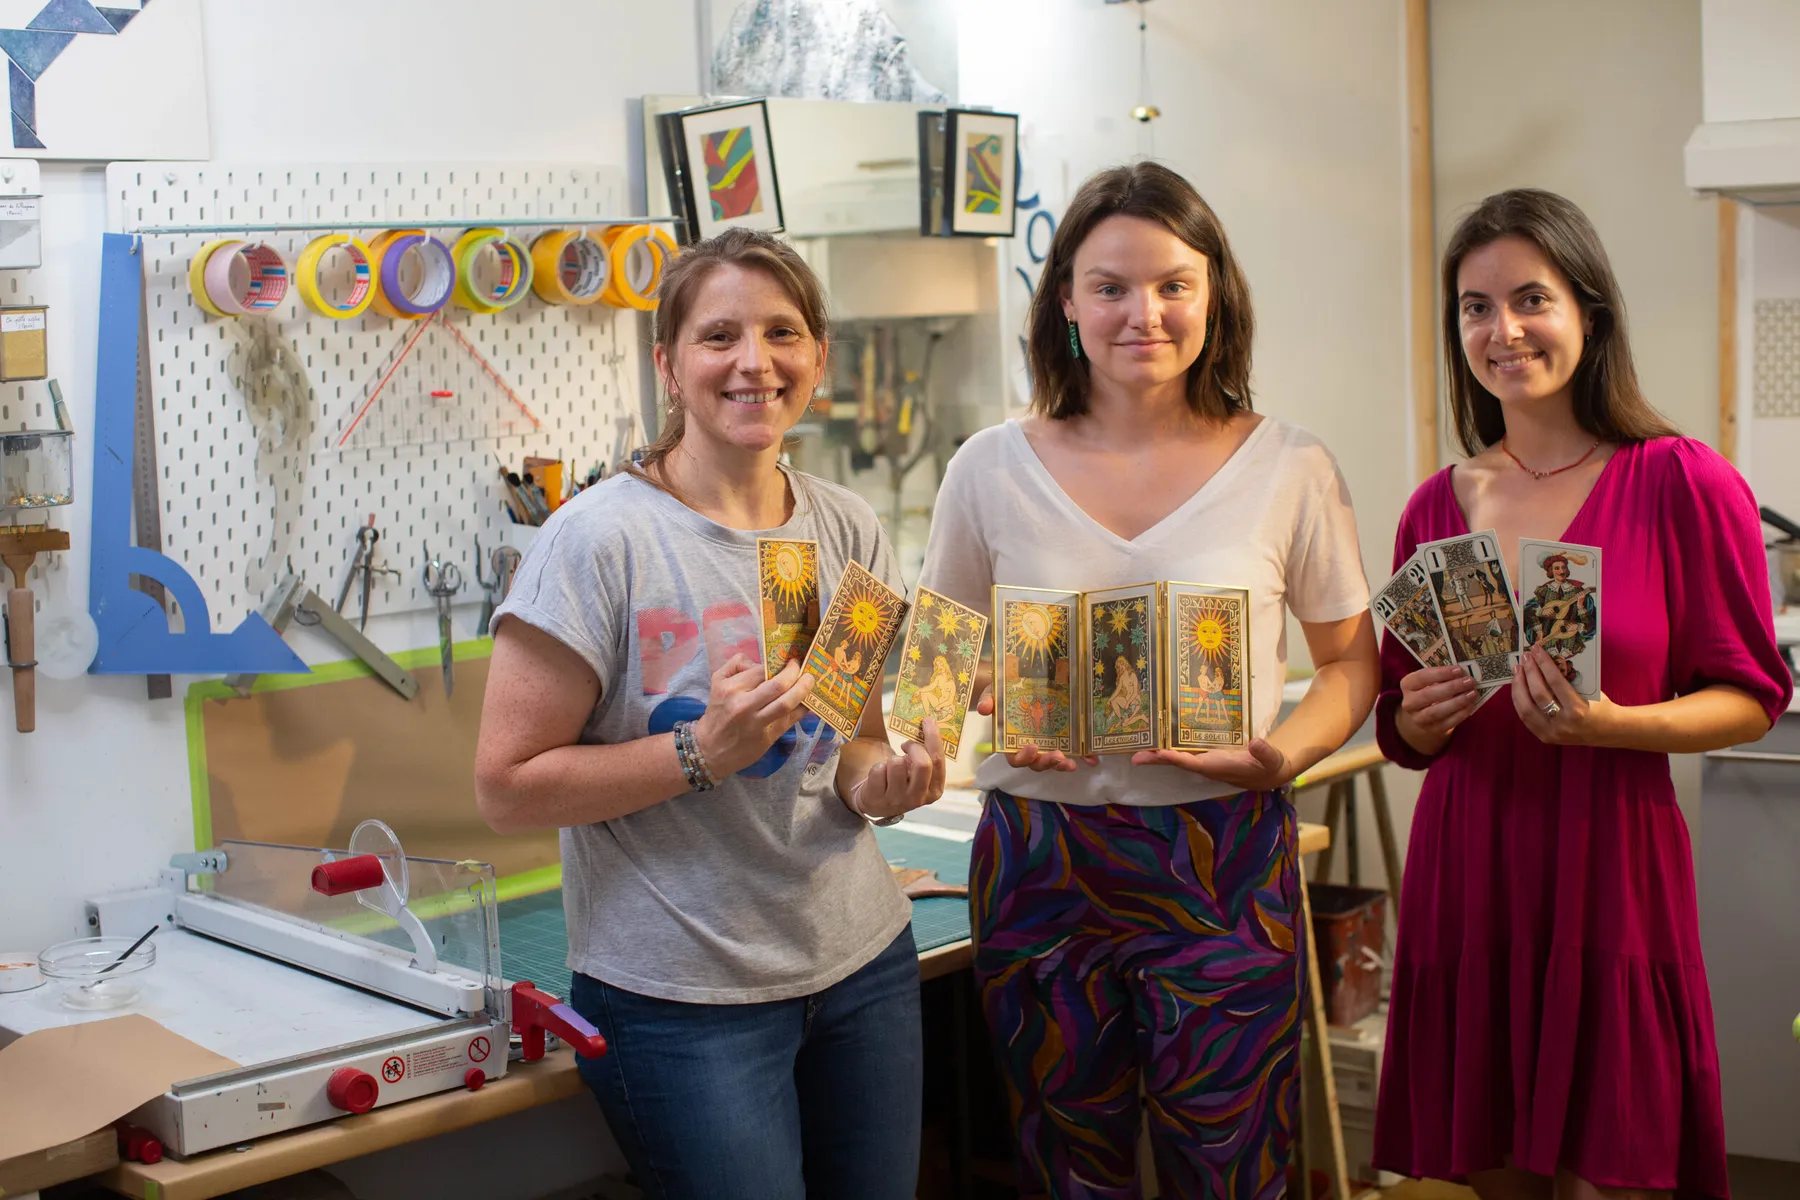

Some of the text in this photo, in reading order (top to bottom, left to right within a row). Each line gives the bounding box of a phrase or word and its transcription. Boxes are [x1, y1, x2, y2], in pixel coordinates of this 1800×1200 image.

[1480, 541, 1489, 558] 1
[1432, 552, 1440, 568] 1
[1377, 597, 1395, 618] 21
[818, 702, 841, 724] SOLEIL
[893, 718, 901, 728] 17
[1182, 730, 1190, 740] 19
[1204, 733, 1229, 741] SOLEIL
[1007, 736, 1015, 745] 18
[1094, 737, 1102, 747] 17
